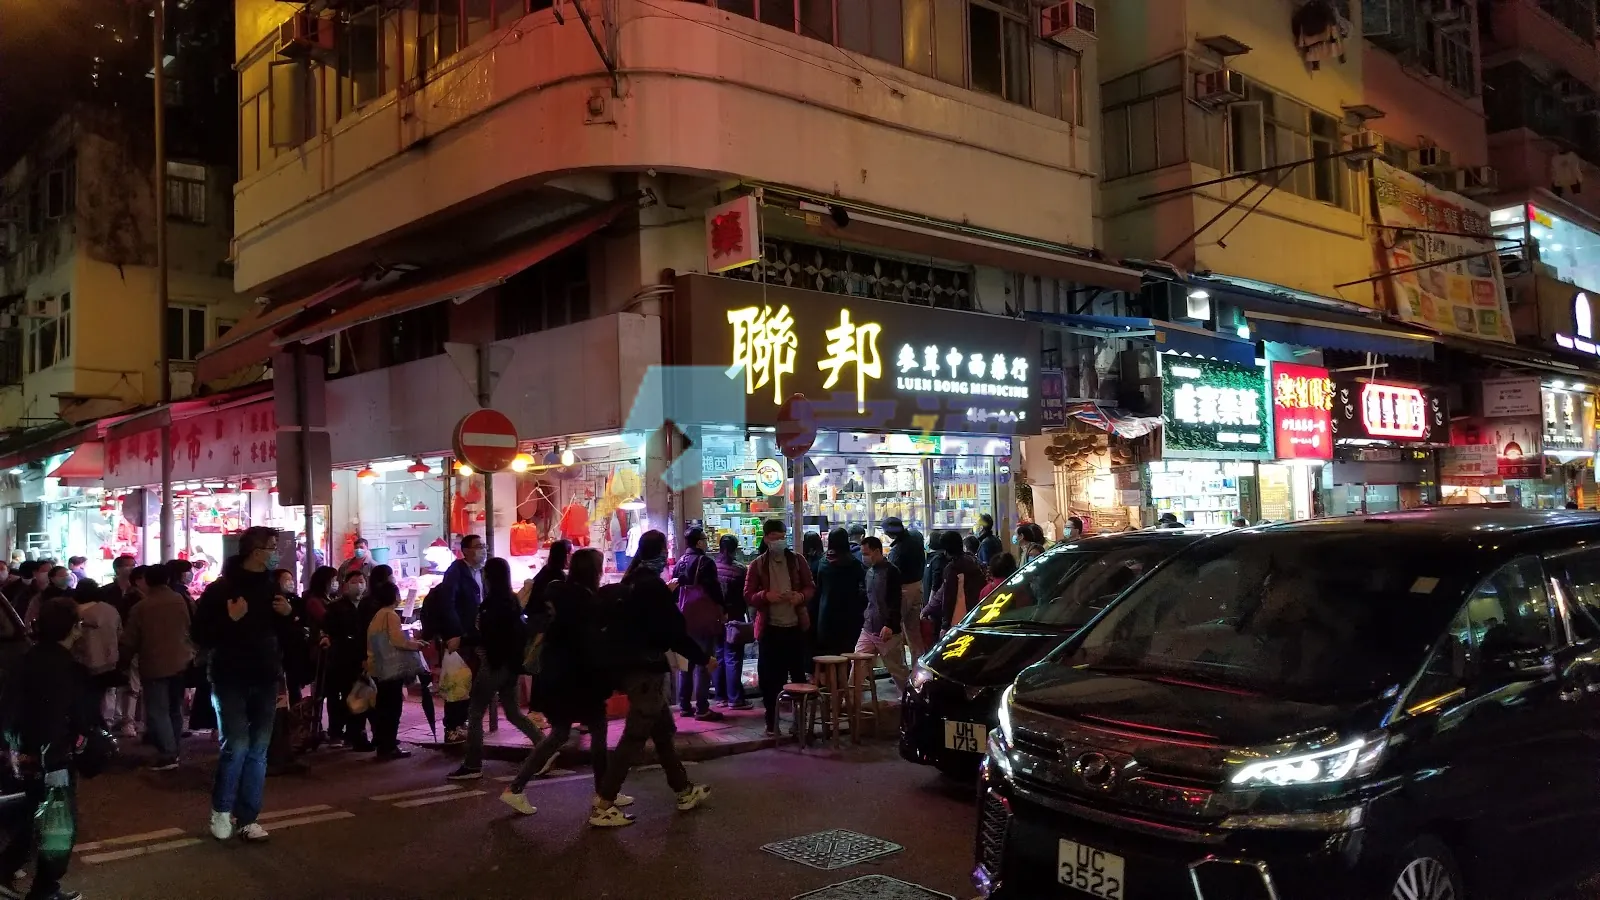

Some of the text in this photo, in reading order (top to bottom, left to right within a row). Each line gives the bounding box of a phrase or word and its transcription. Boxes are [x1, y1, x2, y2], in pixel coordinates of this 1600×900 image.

[725, 304, 883, 414] 聯邦
[897, 377, 1029, 398] LUEN BONG MEDICINE
[956, 723, 974, 738] UH
[953, 736, 978, 753] 1713
[1077, 844, 1105, 873] UC
[1061, 862, 1120, 899] 3522
